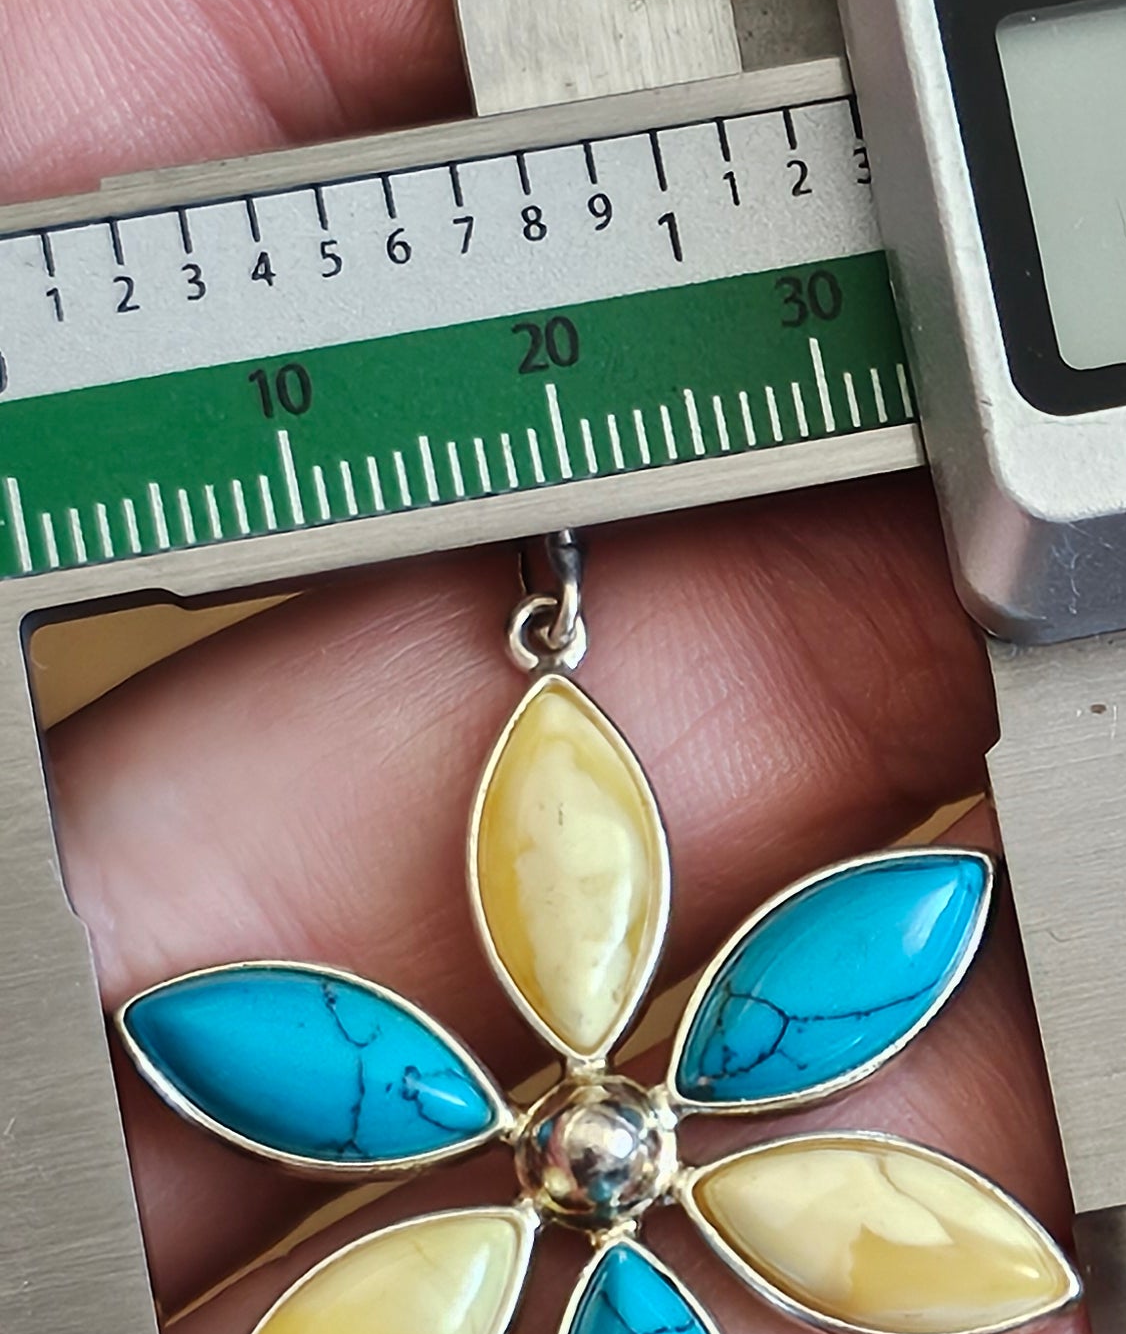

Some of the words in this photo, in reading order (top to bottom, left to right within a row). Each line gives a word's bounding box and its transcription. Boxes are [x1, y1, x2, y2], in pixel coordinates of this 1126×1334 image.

[45, 287, 64, 322] 1
[112, 276, 141, 314] 2
[181, 263, 207, 301] 3
[250, 251, 277, 287] 4
[319, 239, 343, 278] 5
[385, 227, 412, 266] 6
[452, 215, 476, 255] 7
[520, 204, 548, 242] 8
[586, 192, 614, 232] 9
[656, 211, 684, 263] 1
[722, 170, 741, 207] 1
[785, 159, 813, 197] 2
[247, 362, 314, 420] 10
[510, 314, 580, 376] 20
[773, 269, 843, 329] 30
